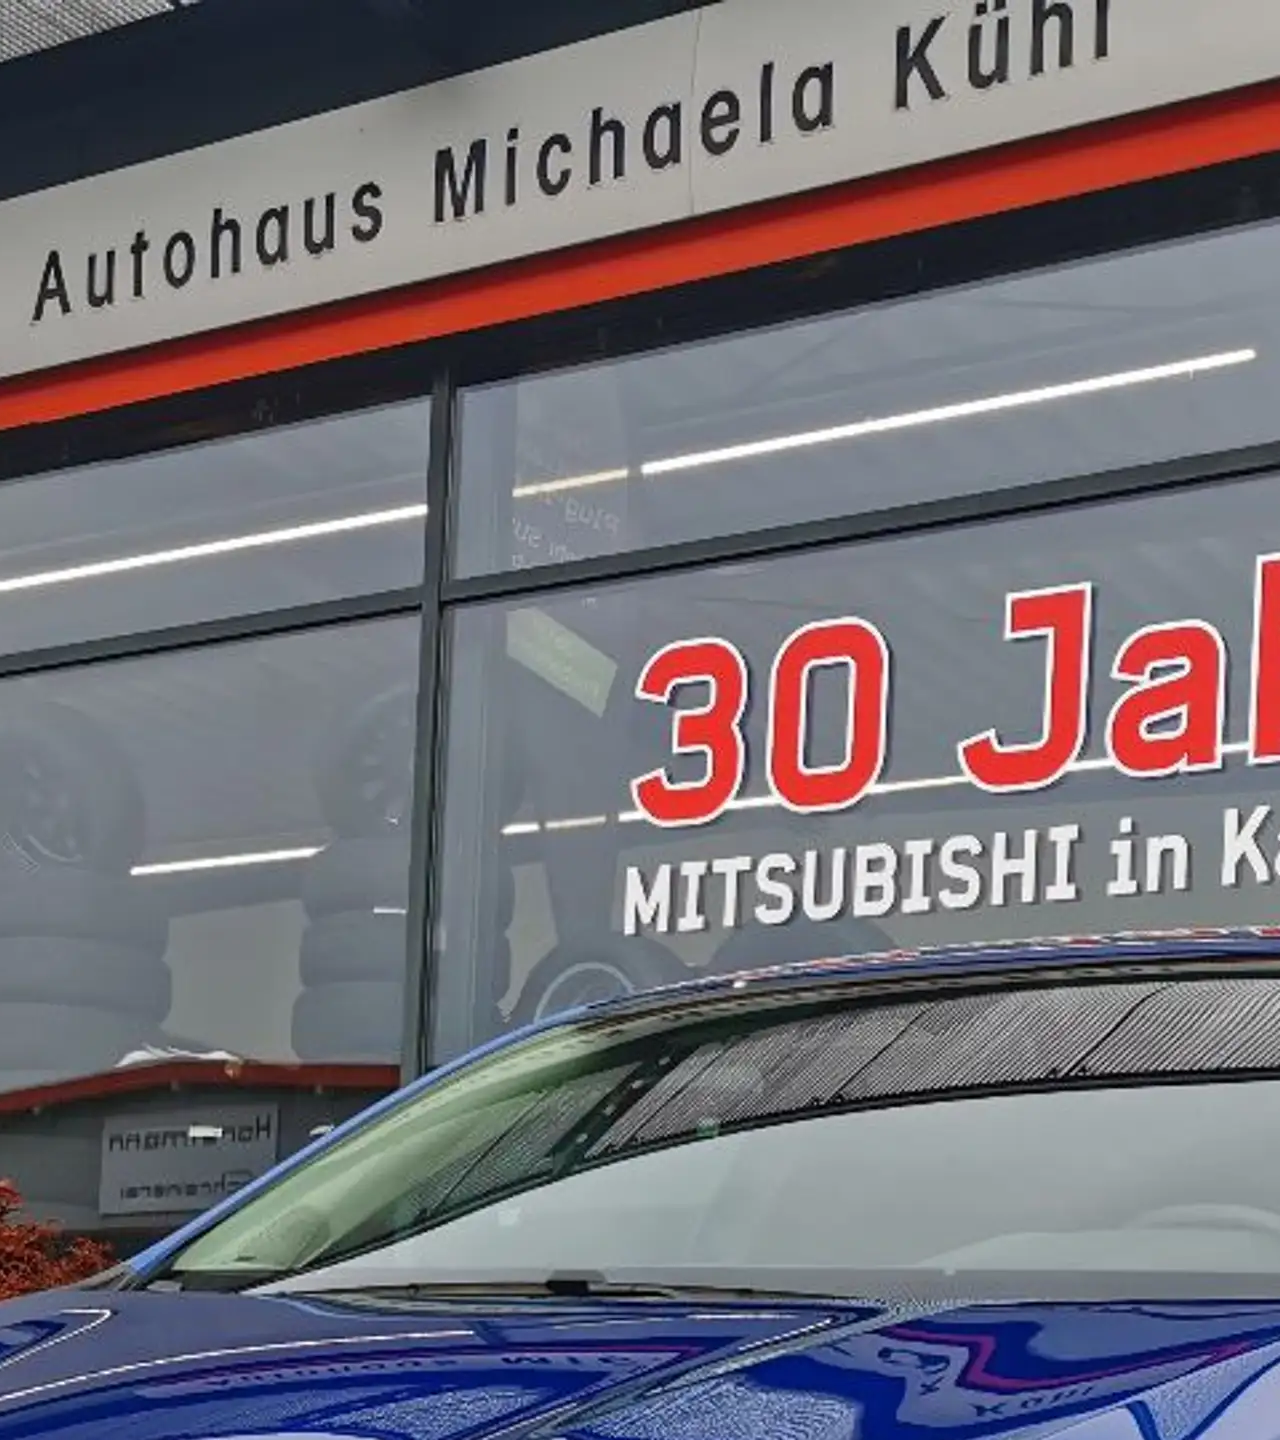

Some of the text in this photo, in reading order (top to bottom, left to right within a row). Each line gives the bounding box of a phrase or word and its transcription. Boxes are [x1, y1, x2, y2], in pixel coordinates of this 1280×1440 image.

[31, 0, 1110, 325] Autohaus Michaela Kühl
[631, 615, 890, 827] 30
[623, 823, 1080, 936] MITSUBISHI
[1107, 817, 1188, 895] in
